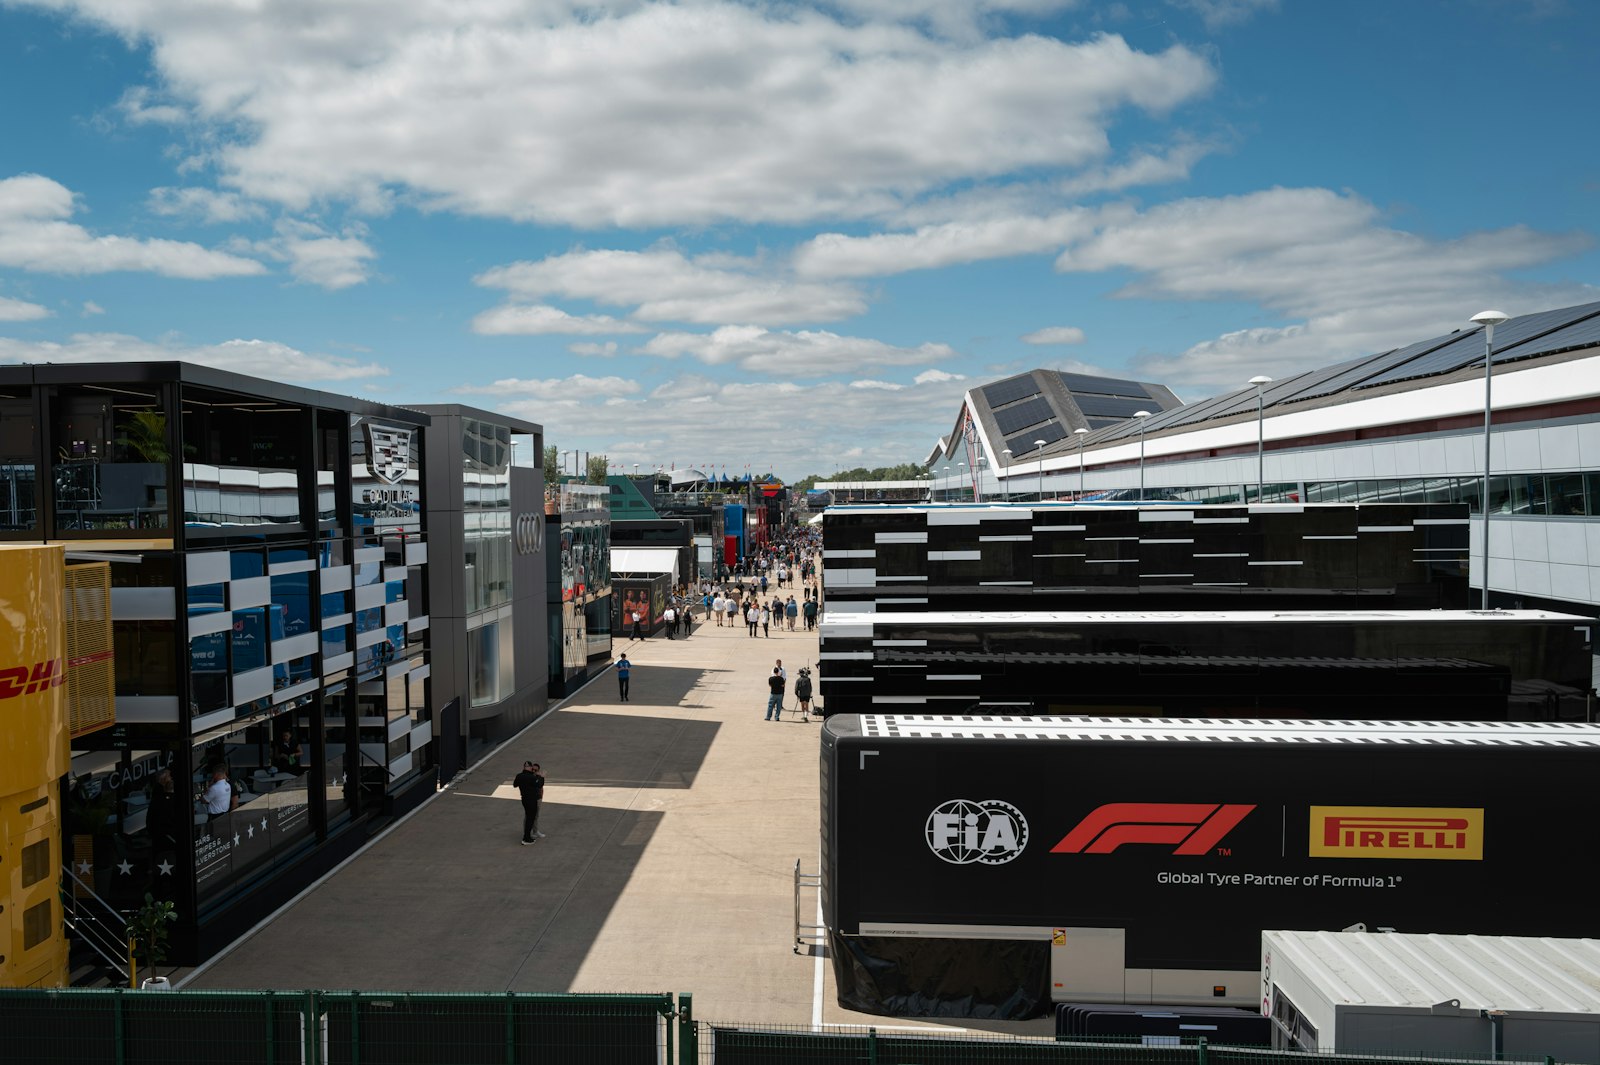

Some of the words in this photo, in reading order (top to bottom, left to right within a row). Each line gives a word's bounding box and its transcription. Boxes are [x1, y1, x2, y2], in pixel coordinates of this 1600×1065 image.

[369, 489, 414, 504] CADILLAC
[0, 657, 64, 700] DHL
[109, 750, 176, 789] CADILLA
[195, 834, 211, 847] TARS
[1049, 802, 1256, 856] F1
[1323, 816, 1469, 849] PIRELLI
[195, 840, 217, 857] TRIPES
[1157, 872, 1204, 884] Global
[1207, 873, 1241, 886] Tyre
[1243, 873, 1300, 886] Partner
[1302, 874, 1319, 886] of
[1322, 875, 1384, 887] Formula
